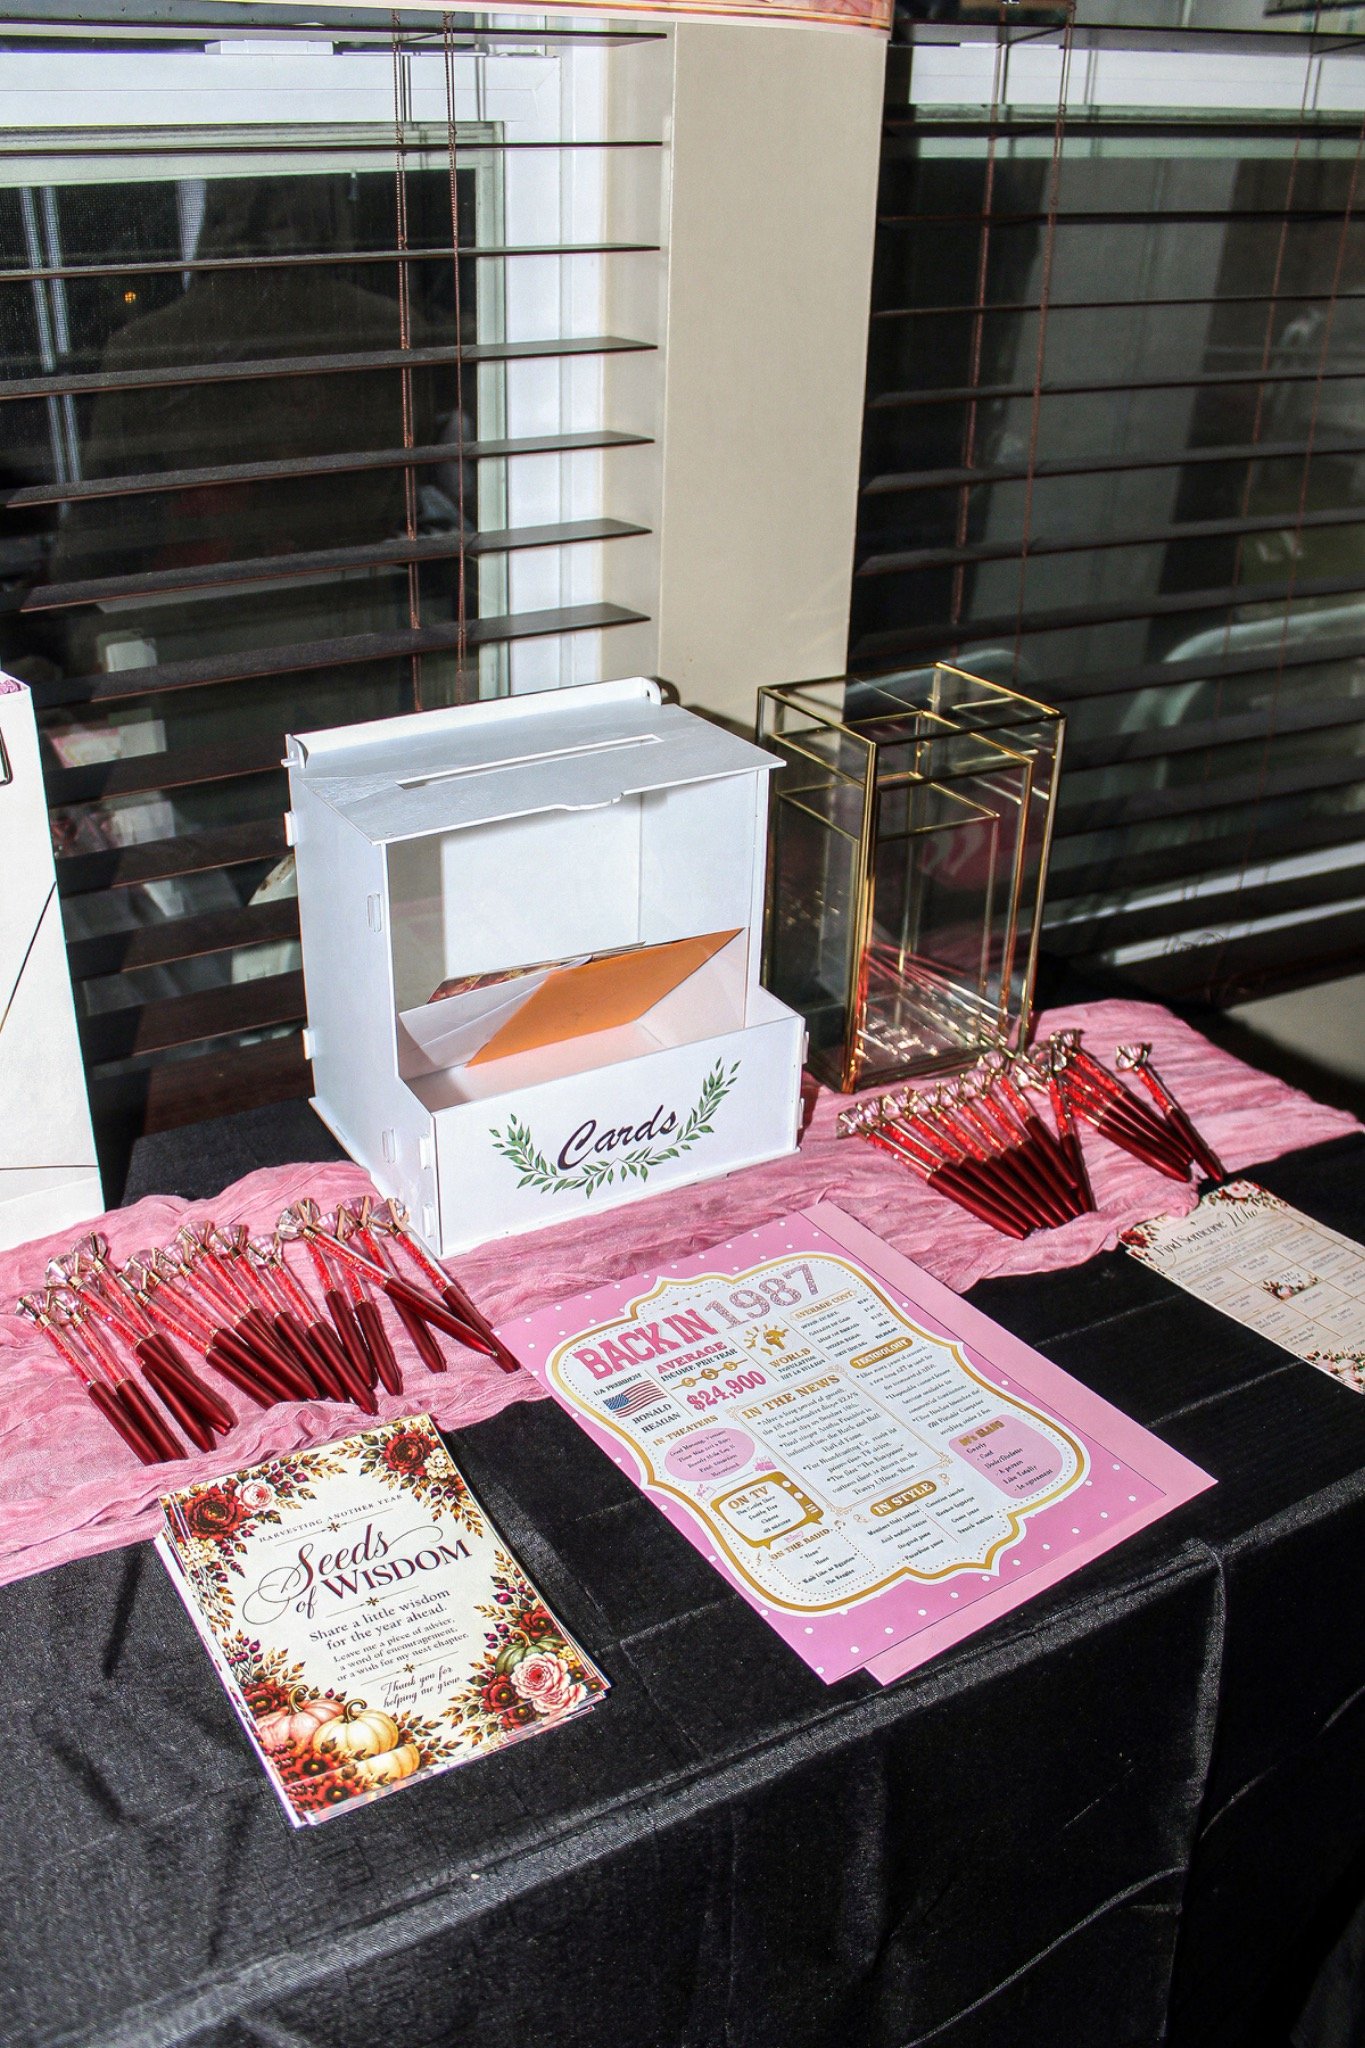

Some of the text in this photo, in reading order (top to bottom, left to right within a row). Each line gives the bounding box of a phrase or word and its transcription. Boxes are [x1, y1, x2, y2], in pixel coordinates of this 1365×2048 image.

[558, 1105, 679, 1171] Cards
[573, 1263, 818, 1379] BACK IN 1987
[794, 1300, 833, 1319] AVERAGE
[830, 1290, 854, 1303] COST
[656, 1340, 728, 1374] AVERAGE
[659, 1347, 738, 1382] INCOME PER YEAR
[768, 1347, 811, 1368] WORLD
[852, 1338, 908, 1367] TECHNOLOGY
[686, 1370, 766, 1411] $24,900
[740, 1374, 841, 1420] IN THE NEWS
[631, 1403, 672, 1424] RONALD
[640, 1411, 681, 1433] REAGAN
[652, 1414, 719, 1446] IN THEATERS
[727, 1484, 769, 1510] ON TV
[872, 1501, 892, 1515] IN
[890, 1482, 933, 1506] STYLE
[258, 1493, 403, 1543] HARVESTING ANOTHER YEAR
[768, 1527, 830, 1561] ON THE RADIO
[256, 1523, 424, 1616] Seeds
[296, 1539, 473, 1619] of WISDOM
[308, 1589, 450, 1642] Share a little wisdom
[326, 1602, 447, 1650] for the year ahead.
[332, 1649, 361, 1663] Leave
[362, 1643, 377, 1653] me
[386, 1632, 411, 1646] piece
[411, 1626, 422, 1636] of
[423, 1617, 456, 1632] advice,
[336, 1673, 347, 1682] or
[355, 1662, 379, 1675] wish
[378, 1657, 394, 1667] for
[395, 1653, 410, 1662] my
[410, 1644, 432, 1657] next
[432, 1632, 469, 1649] chapter.
[347, 1653, 372, 1668] word
[372, 1649, 384, 1659] of
[385, 1627, 458, 1655] encouragement,
[379, 1664, 453, 1696] Thank you for
[382, 1676, 463, 1709] helping me grow.
